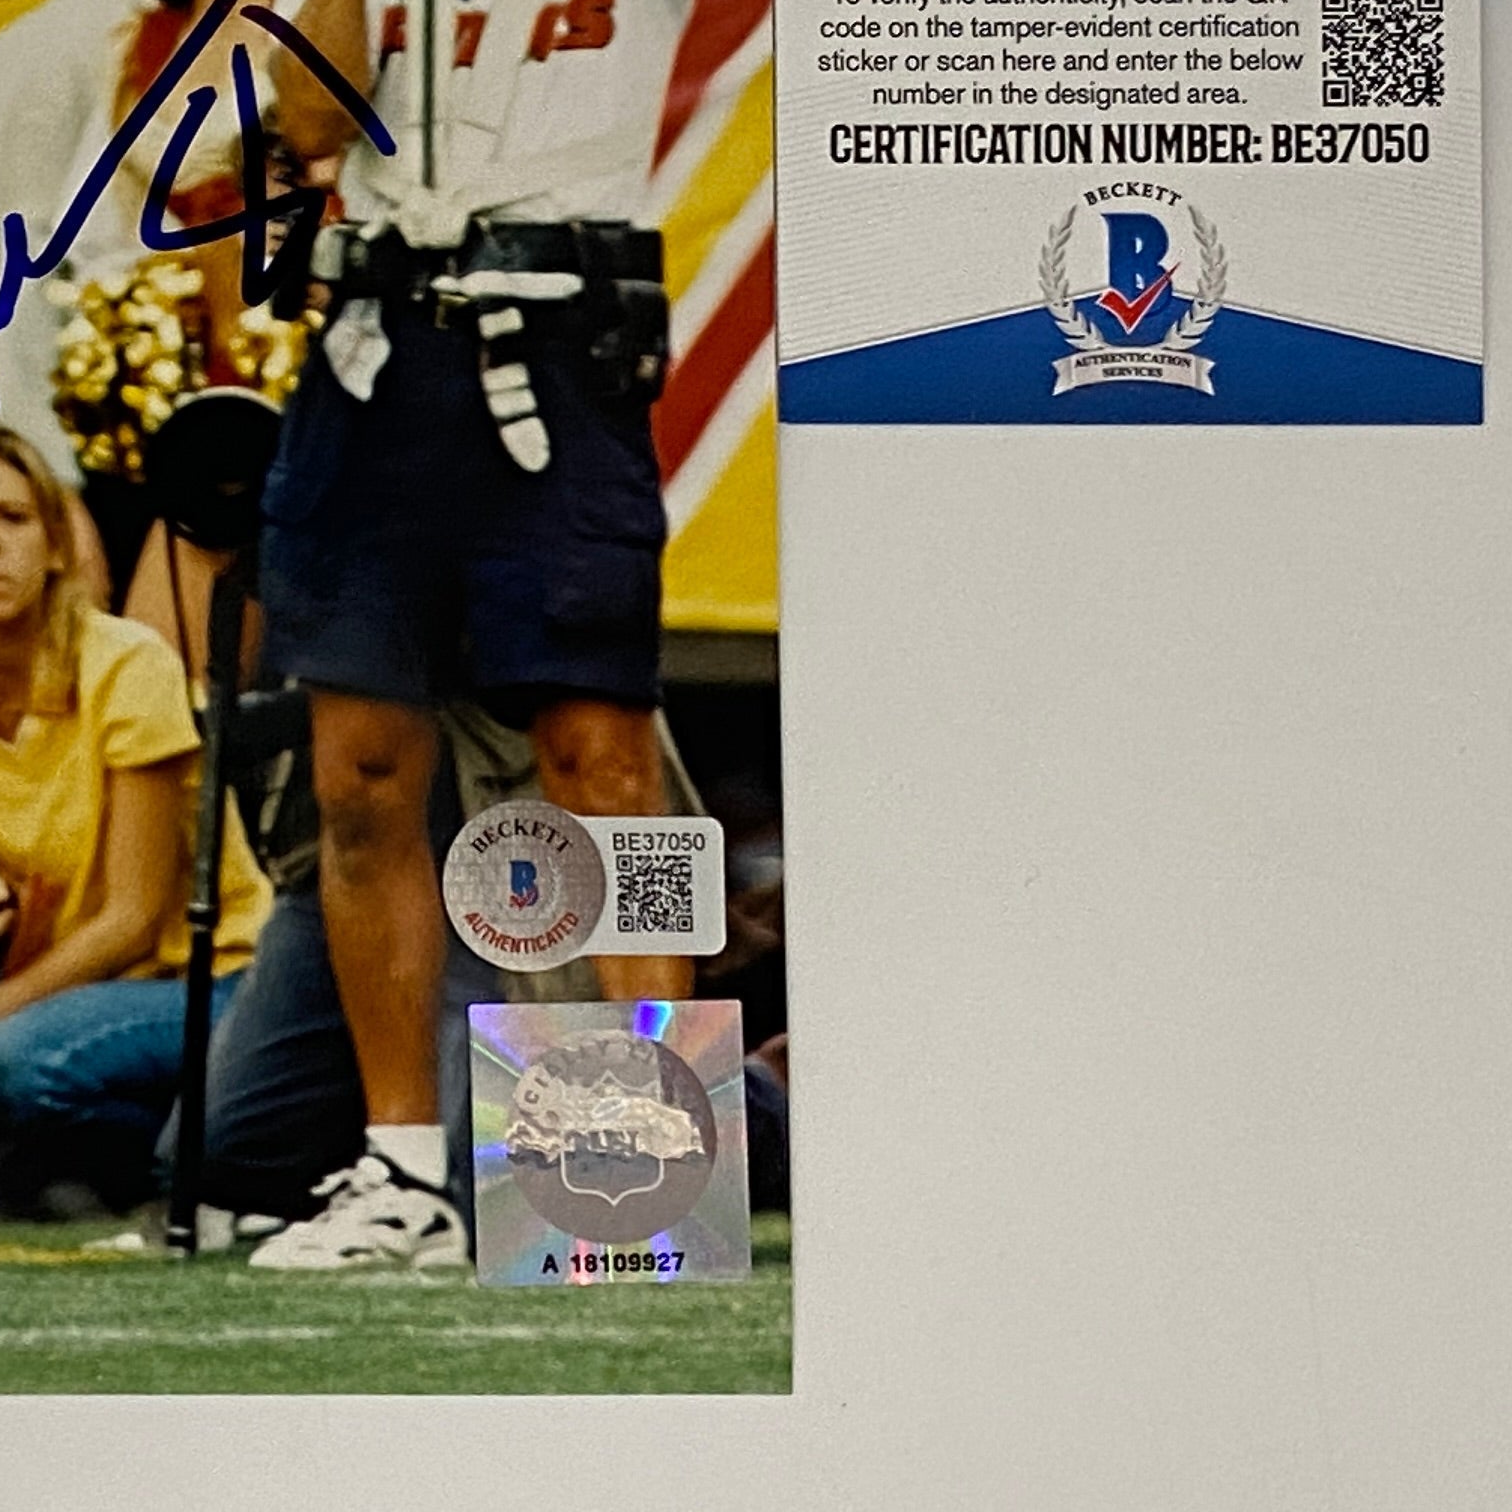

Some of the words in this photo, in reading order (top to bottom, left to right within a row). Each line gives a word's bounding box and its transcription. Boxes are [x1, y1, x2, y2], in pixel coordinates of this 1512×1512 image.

[820, 14, 882, 39] code
[888, 21, 919, 39] on
[925, 14, 964, 39] the
[970, 14, 1152, 44] tamper-evident
[1158, 13, 1300, 38] certification
[817, 48, 899, 72] sticker
[904, 54, 931, 72] or
[936, 54, 995, 72] scan
[1002, 47, 1057, 72] here
[1062, 47, 1109, 72] and
[1115, 50, 1179, 72] enter
[1183, 47, 1223, 72] the
[1229, 47, 1304, 72] below
[872, 81, 967, 105] number
[972, 81, 993, 105] in
[999, 80, 1038, 105] the
[1044, 80, 1181, 111] designated
[1186, 87, 1248, 105] area.
[829, 123, 1093, 165] CERTIFICATION
[1101, 123, 1263, 164] NUMBER:
[1270, 122, 1430, 164] BE37050
[1083, 181, 1183, 207] BECKETT
[1073, 352, 1192, 369] AUTHENTICATION
[1101, 366, 1164, 378] SERVICES
[469, 817, 574, 856] BECKETT
[612, 832, 706, 852] BE37050
[464, 911, 581, 955] AUTHENTICATED
[542, 1253, 559, 1274] A
[570, 1252, 686, 1274] 18109927
